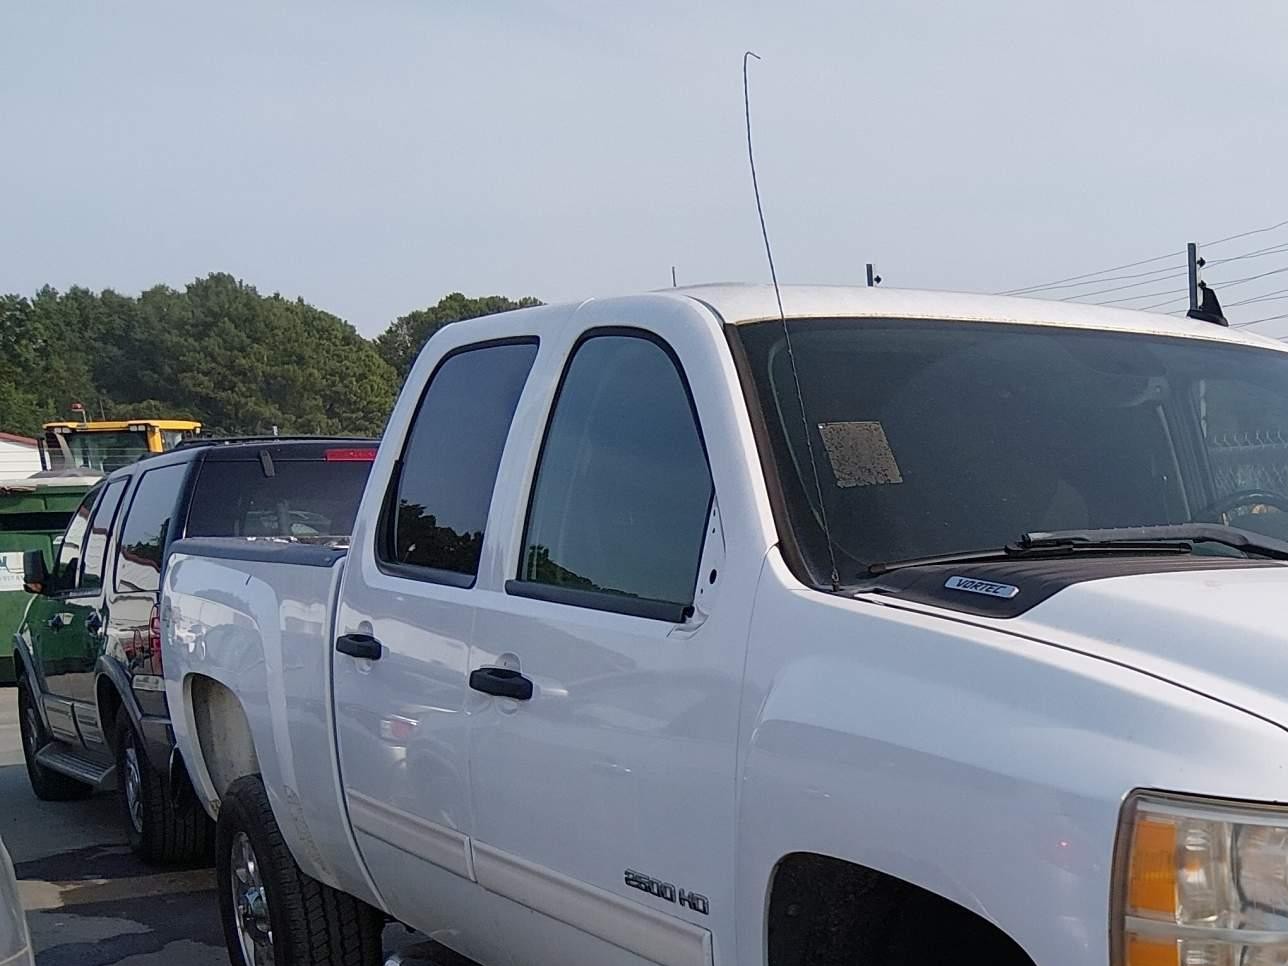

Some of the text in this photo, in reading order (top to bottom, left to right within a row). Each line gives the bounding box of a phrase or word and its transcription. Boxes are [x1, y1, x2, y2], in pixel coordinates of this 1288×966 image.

[956, 579, 1007, 594] VORTEC
[624, 868, 709, 915] 2500 HD
